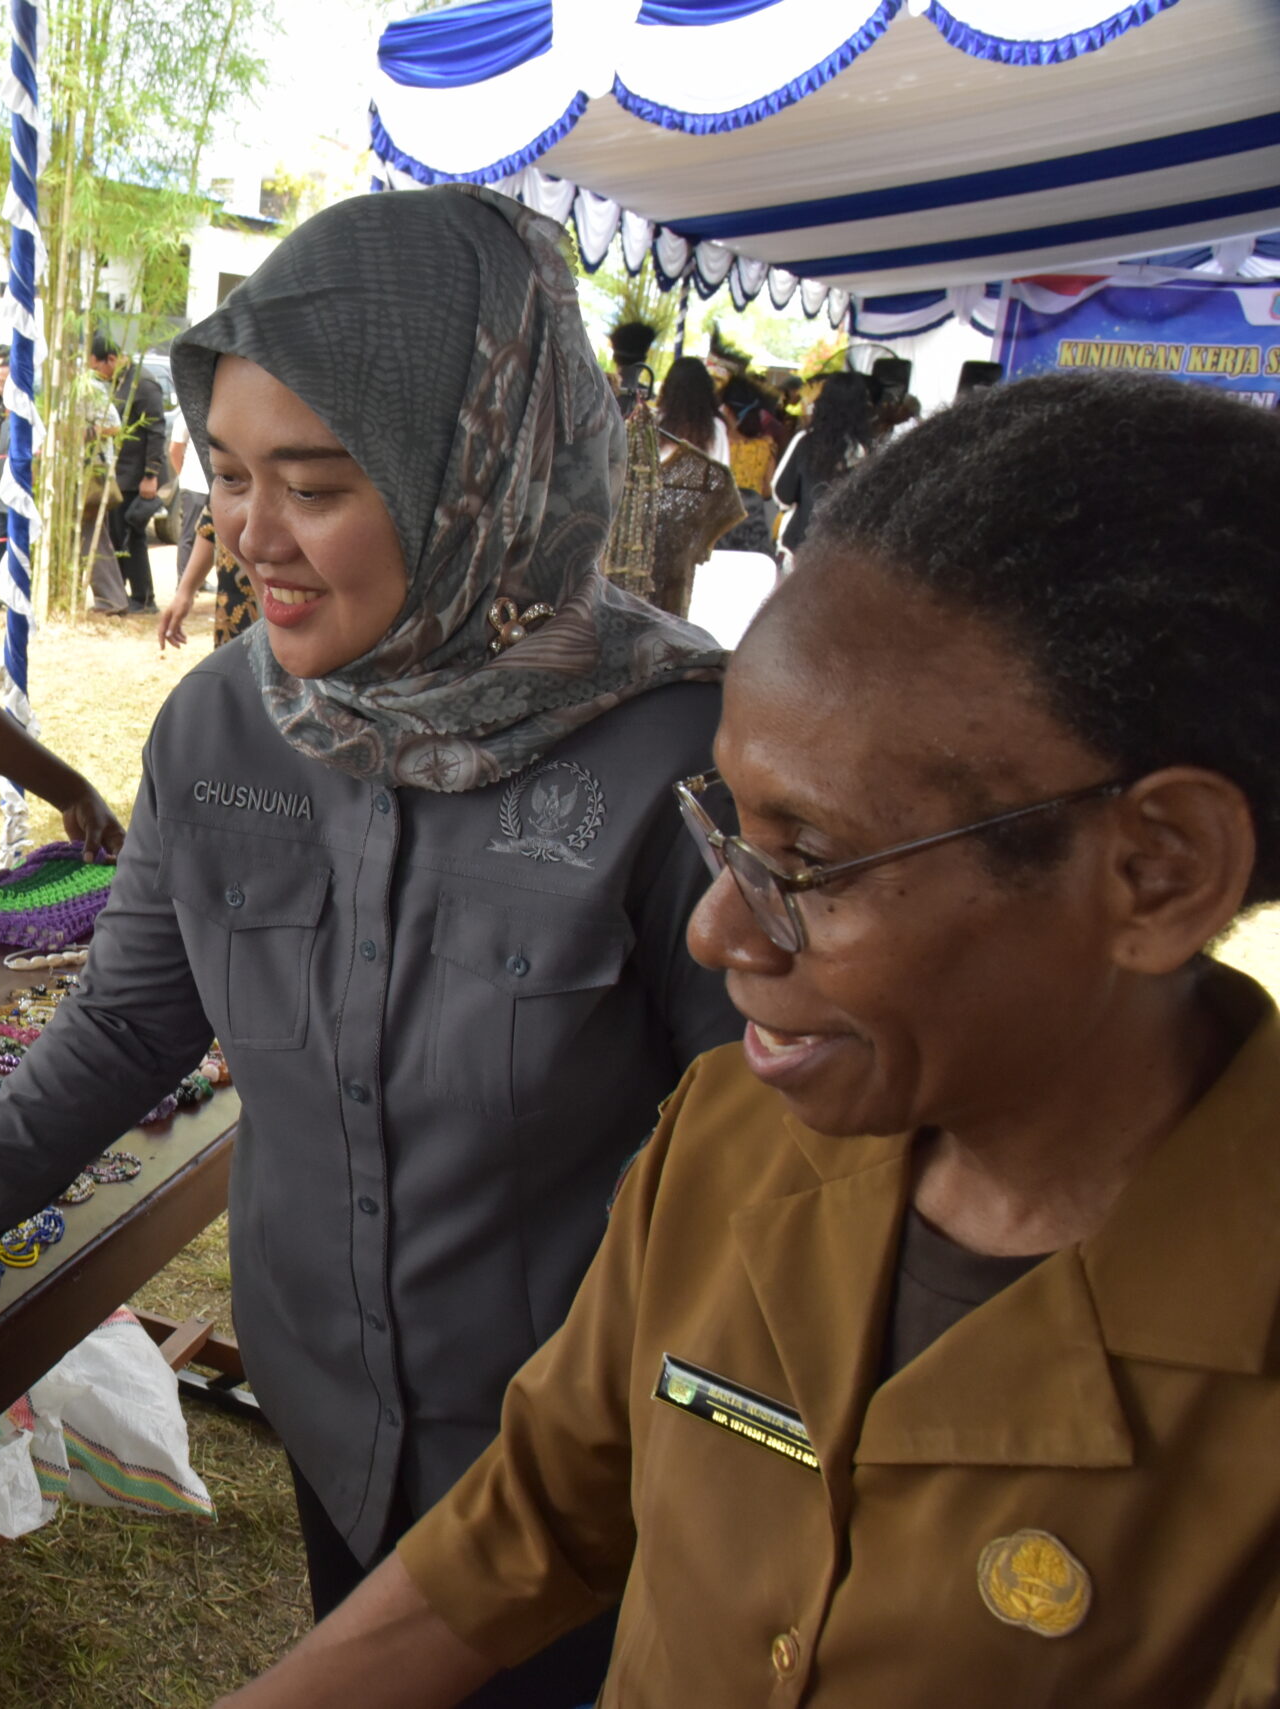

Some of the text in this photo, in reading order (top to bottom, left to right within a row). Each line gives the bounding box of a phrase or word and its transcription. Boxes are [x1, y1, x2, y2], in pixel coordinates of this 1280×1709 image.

[1058, 340, 1183, 372] KUNJUNGAN
[1185, 345, 1262, 378] KERJA
[193, 779, 312, 820] CHUSNUNIA
